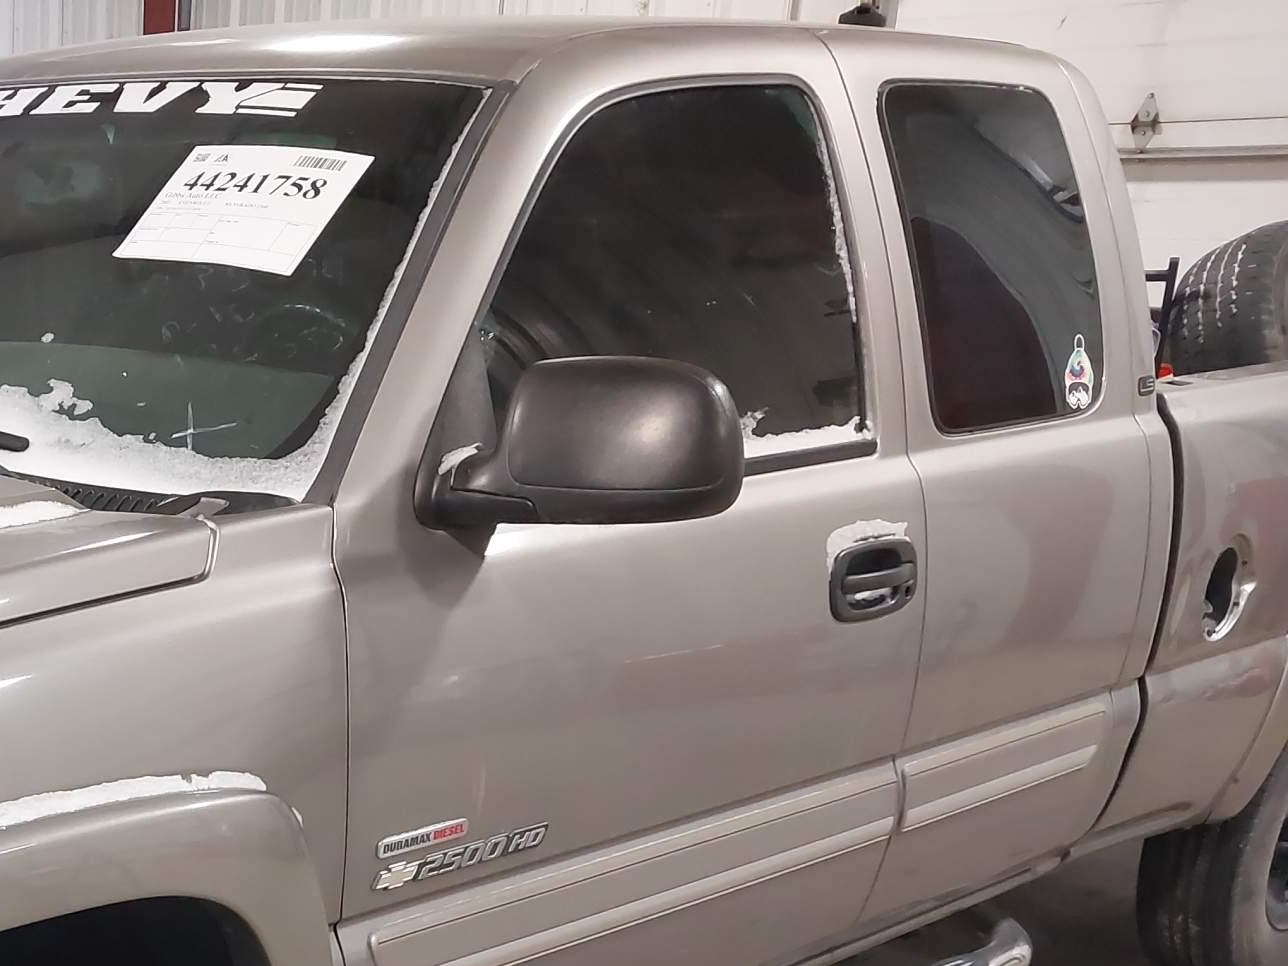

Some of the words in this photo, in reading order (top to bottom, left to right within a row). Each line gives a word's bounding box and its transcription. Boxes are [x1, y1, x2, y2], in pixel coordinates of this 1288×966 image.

[184, 171, 328, 200] 44241758
[382, 831, 431, 855] DURAMAX
[433, 822, 465, 841] DIESEL
[419, 834, 509, 880] 2500
[509, 824, 548, 853] HD
